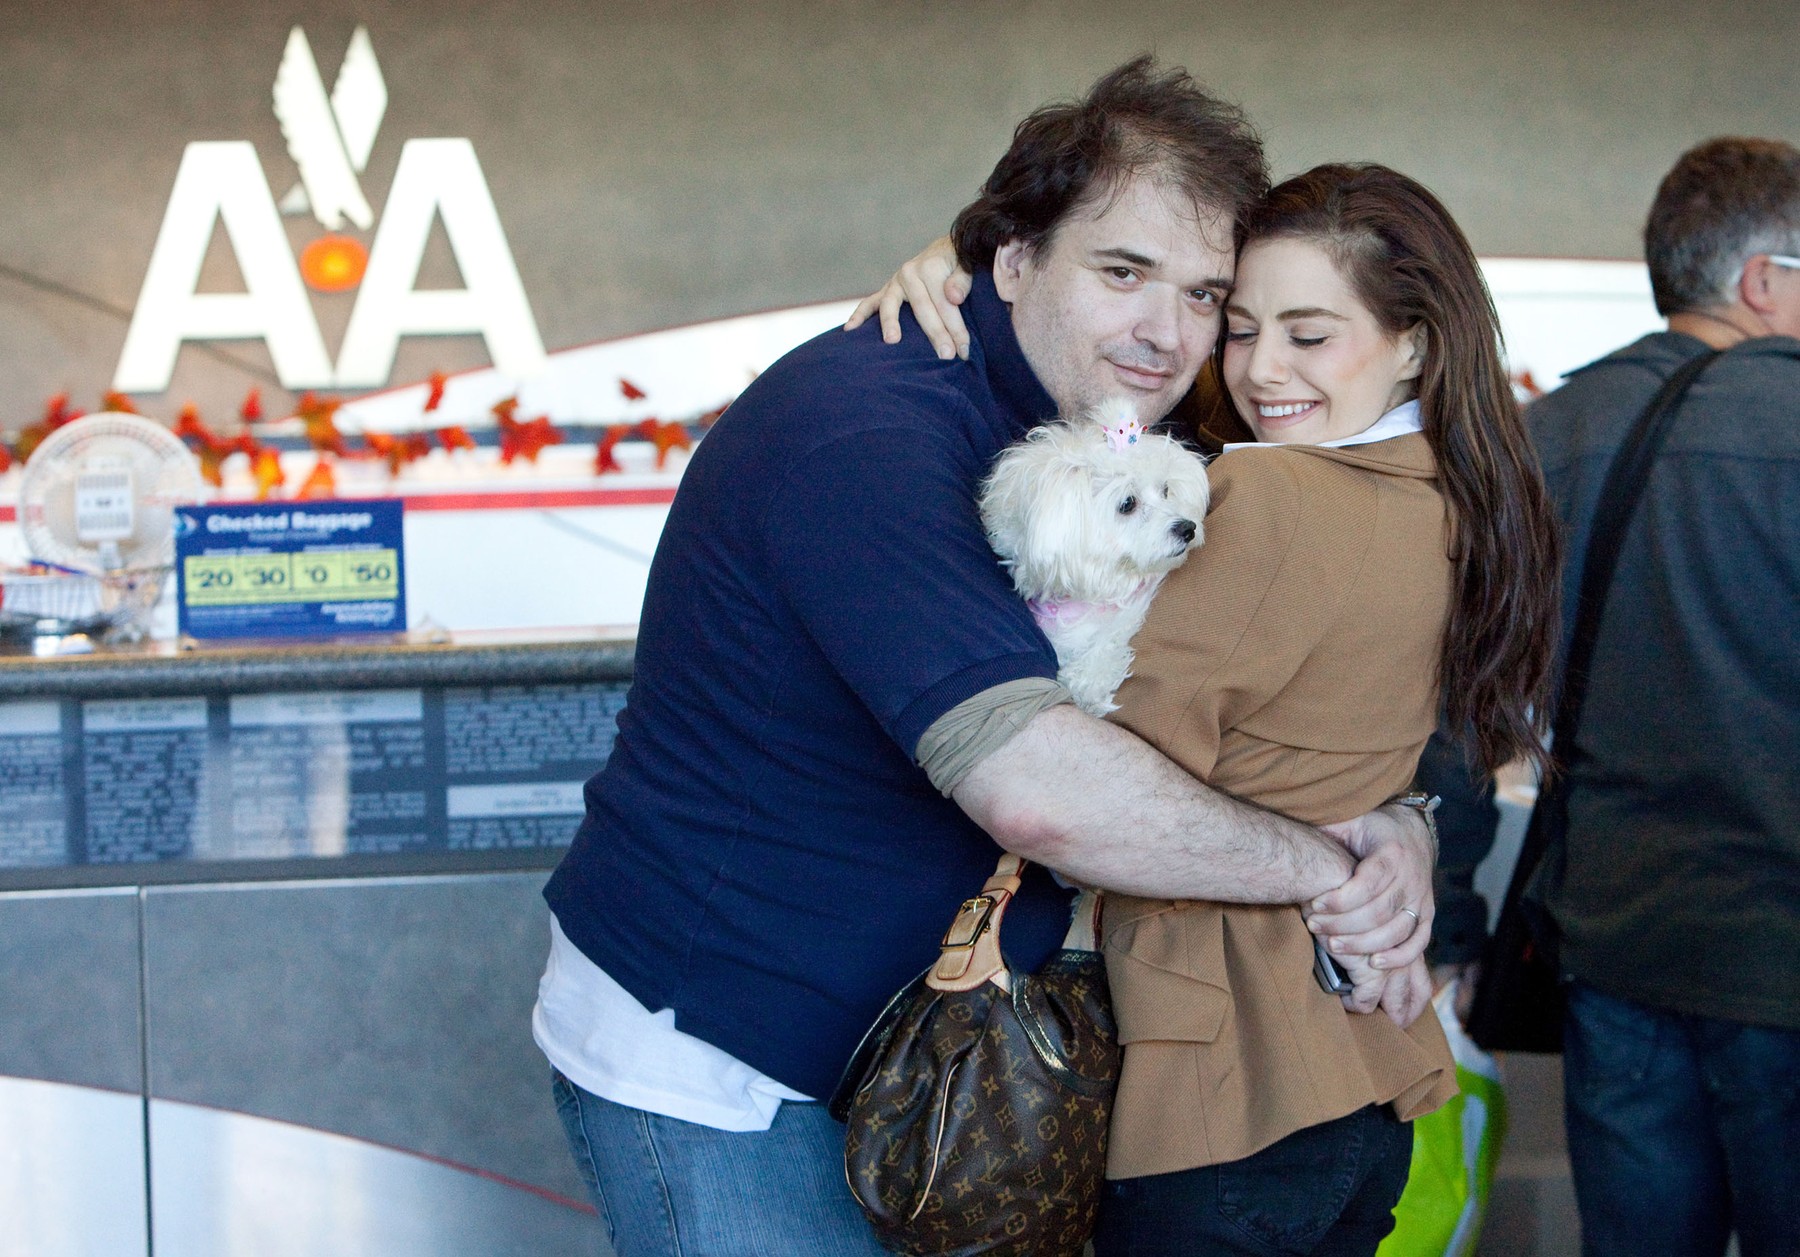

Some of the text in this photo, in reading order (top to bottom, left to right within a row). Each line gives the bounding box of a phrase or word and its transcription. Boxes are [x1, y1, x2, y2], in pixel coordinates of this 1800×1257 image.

[113, 137, 547, 393] AA
[206, 511, 373, 533] Checked Baggage
